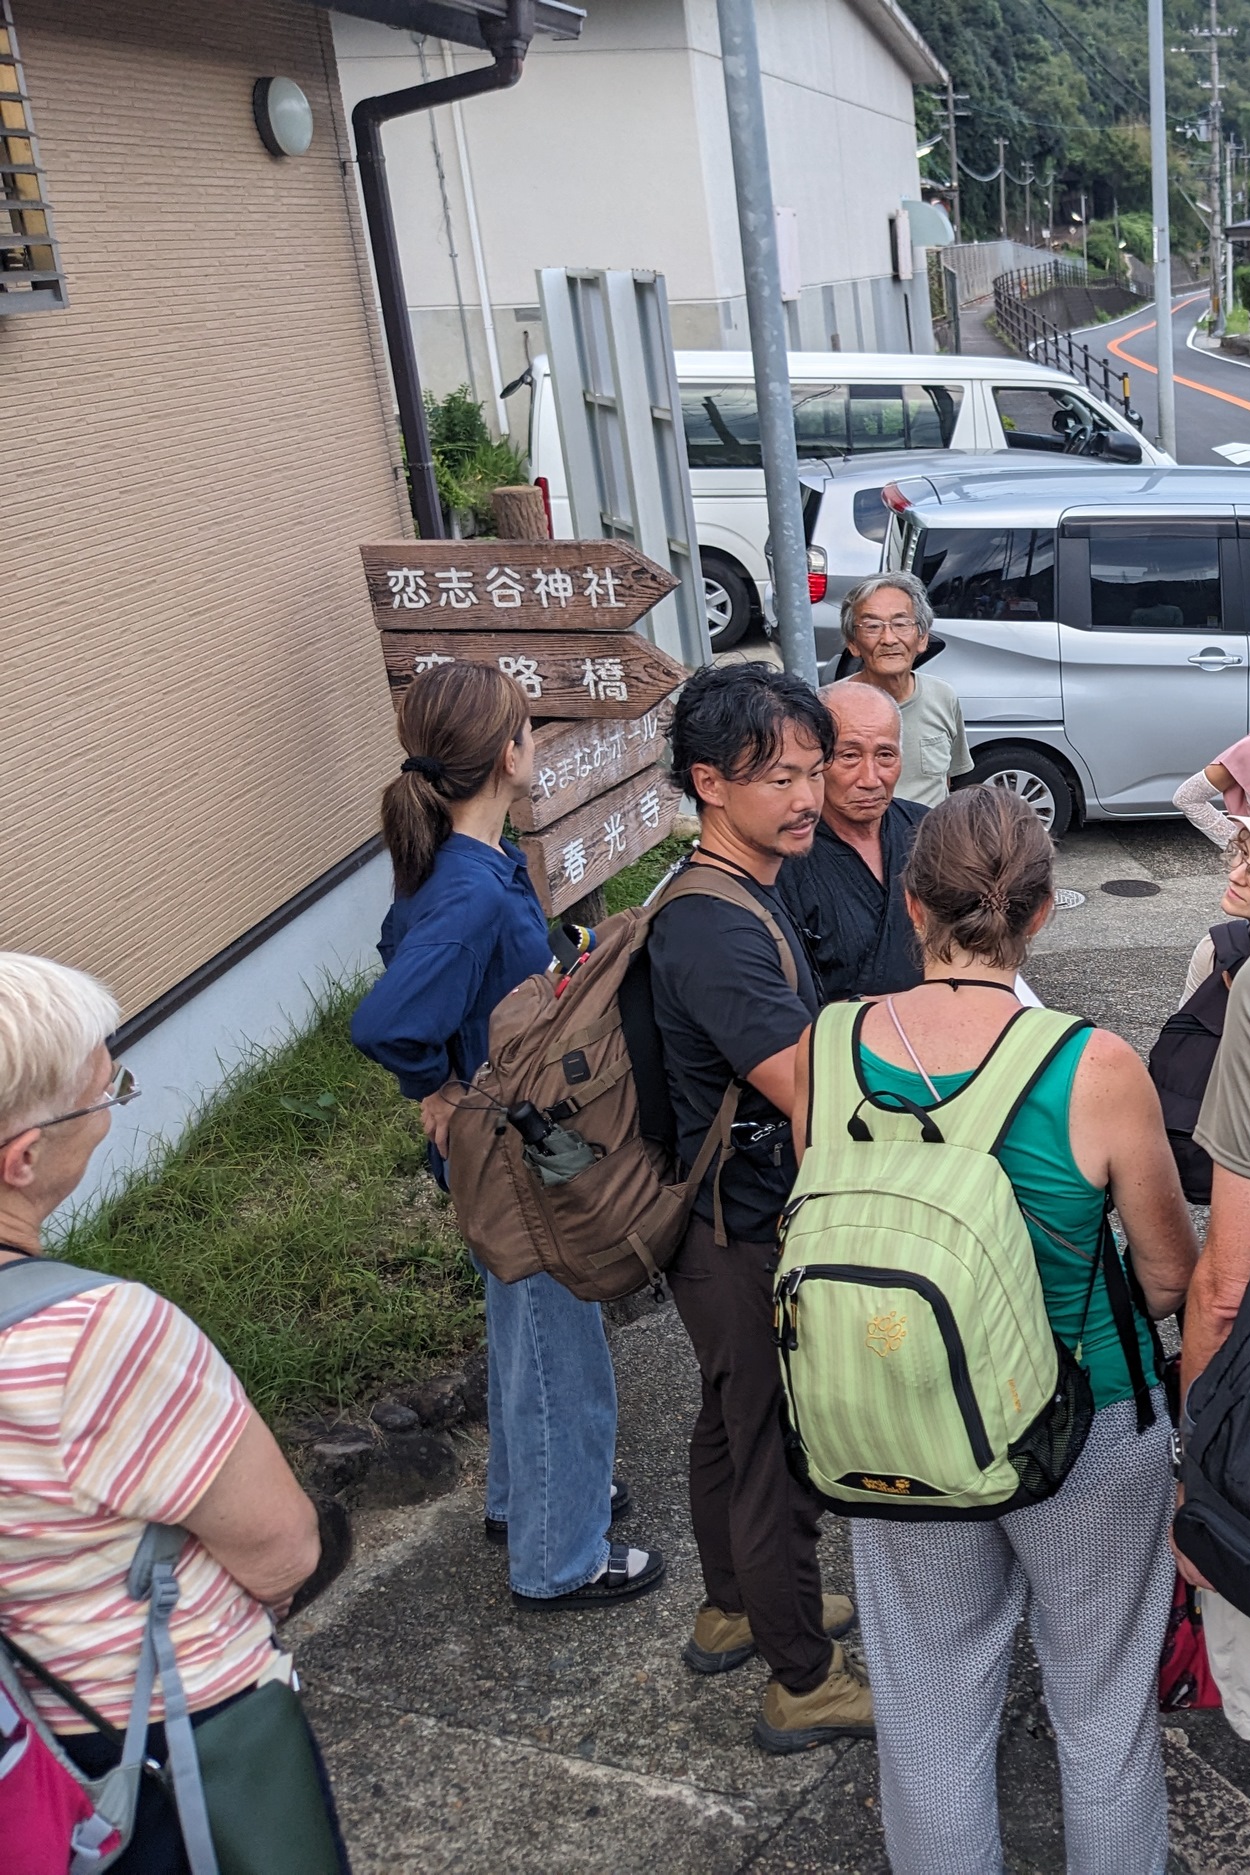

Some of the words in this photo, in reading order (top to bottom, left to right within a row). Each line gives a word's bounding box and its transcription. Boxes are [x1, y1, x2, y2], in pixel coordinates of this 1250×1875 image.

[386, 566, 626, 609] 恋志谷神社
[538, 710, 659, 799] やまなみホール
[562, 788, 661, 885] 春光寺
